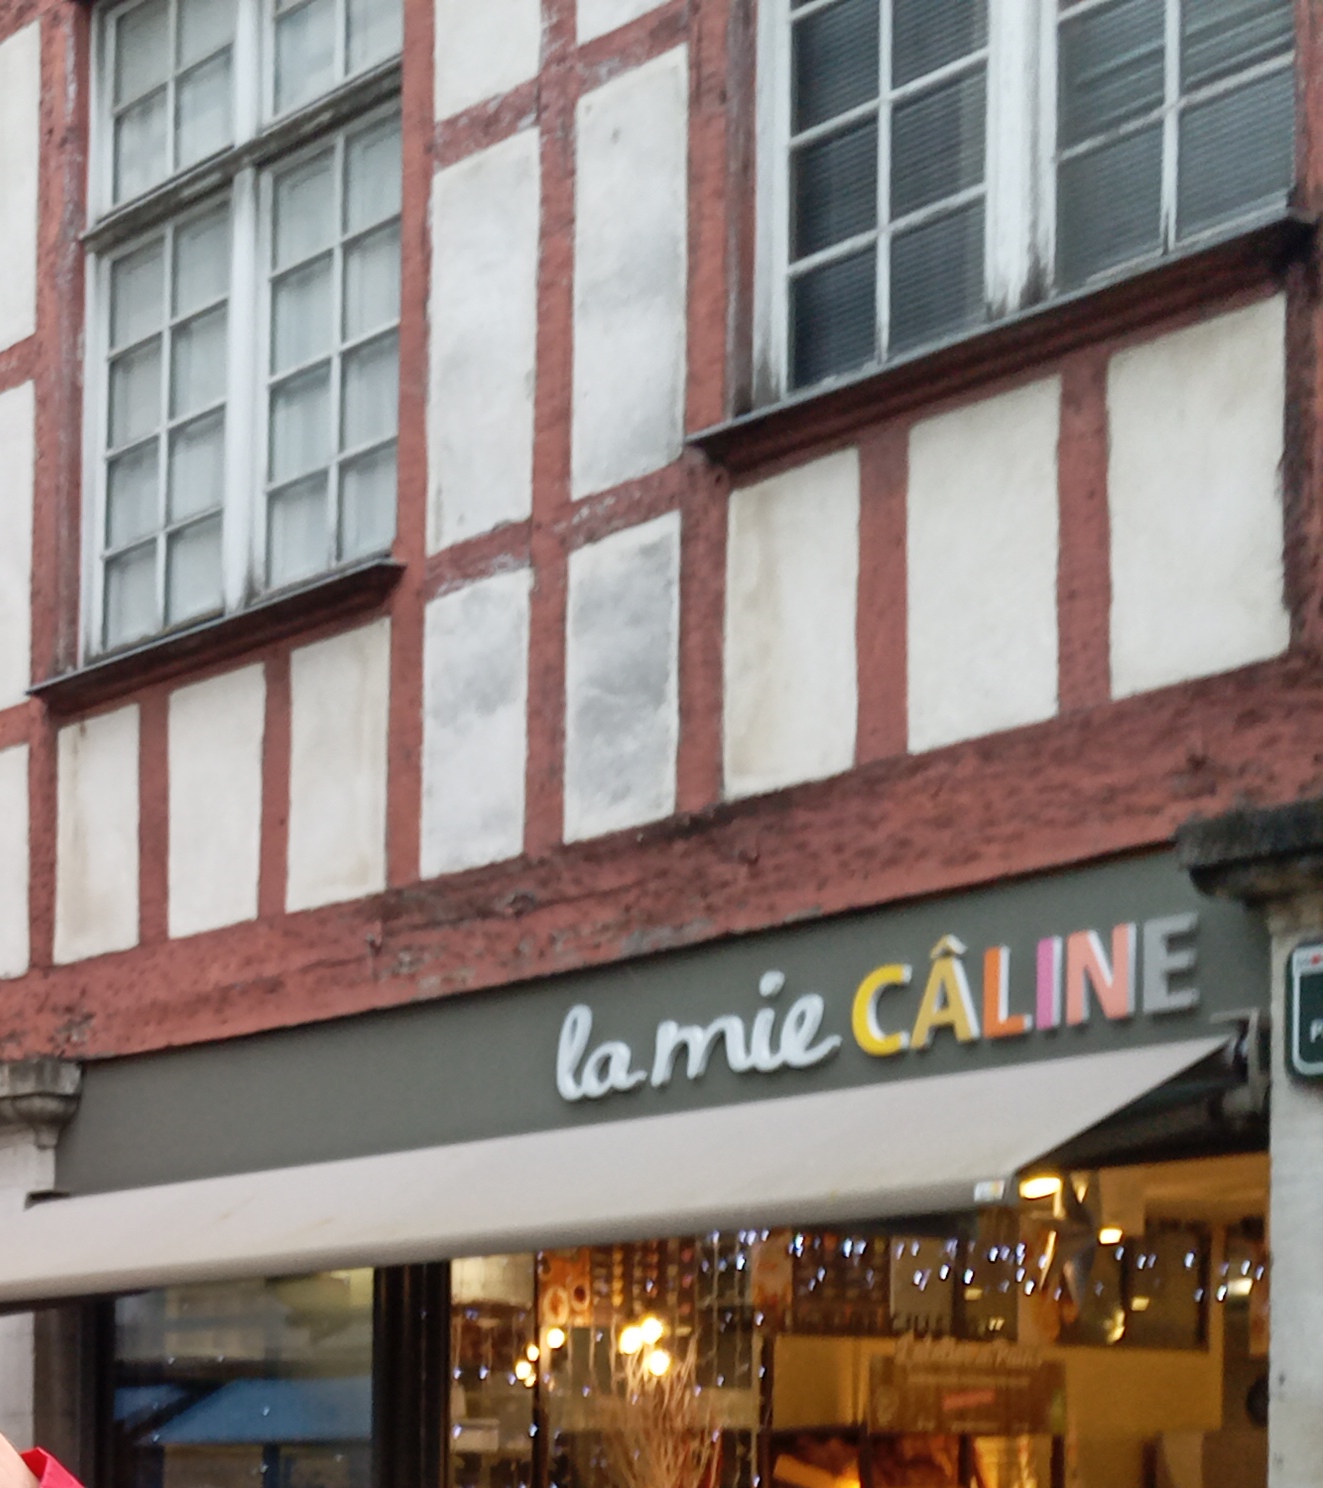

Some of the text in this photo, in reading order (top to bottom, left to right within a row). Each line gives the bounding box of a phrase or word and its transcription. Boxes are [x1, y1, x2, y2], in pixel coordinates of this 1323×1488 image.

[557, 912, 1202, 1102] la mie CÂLINE
